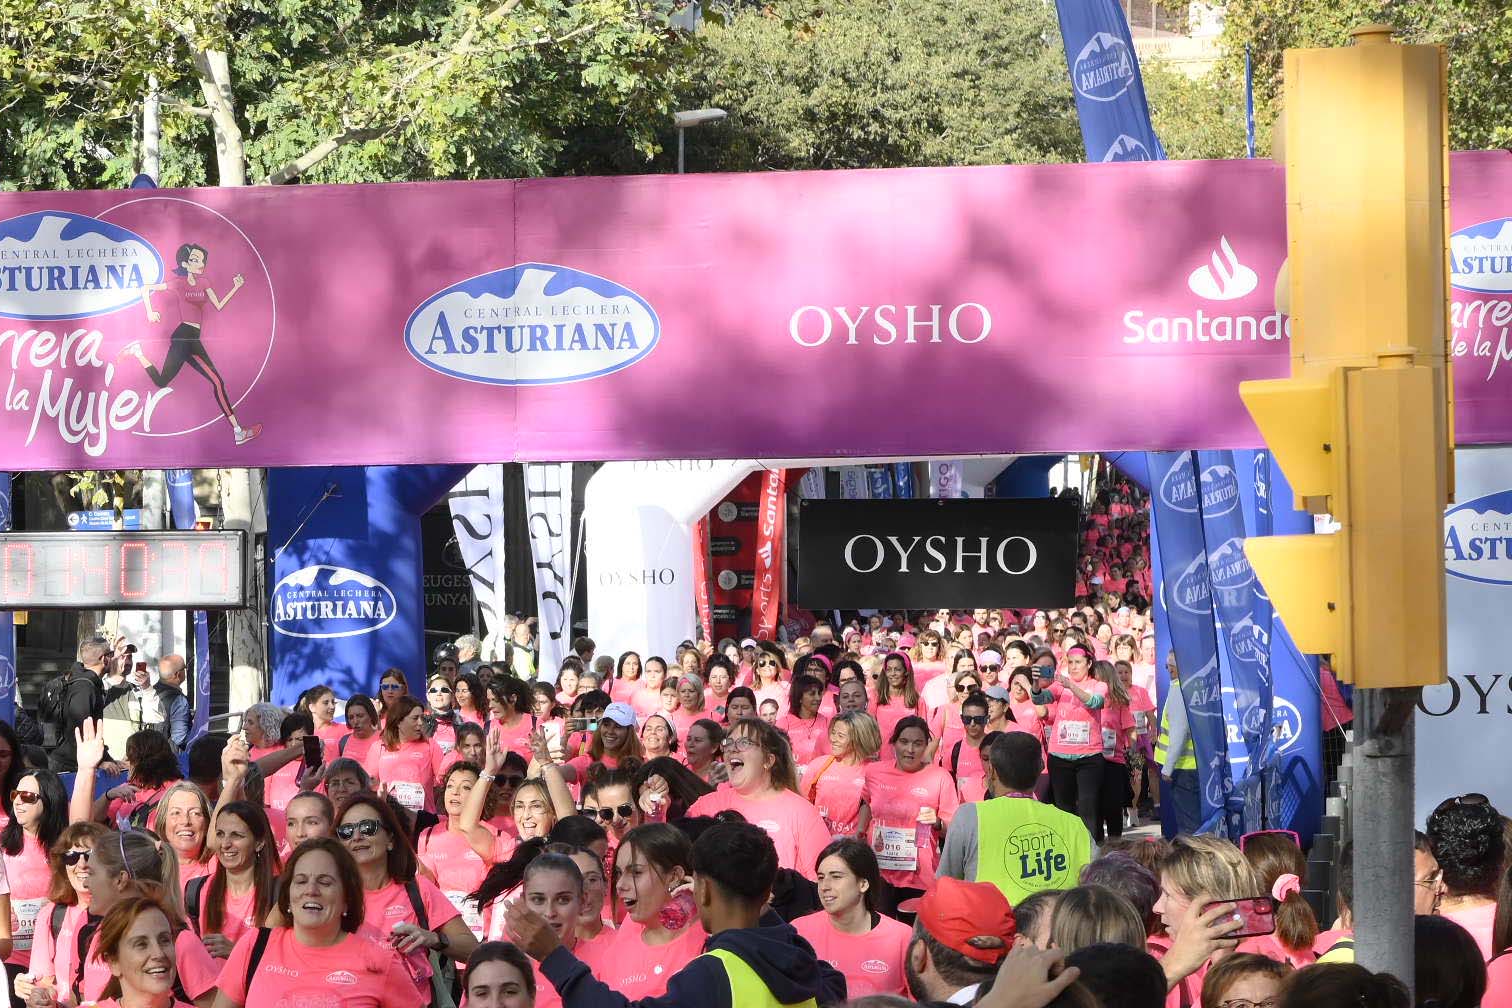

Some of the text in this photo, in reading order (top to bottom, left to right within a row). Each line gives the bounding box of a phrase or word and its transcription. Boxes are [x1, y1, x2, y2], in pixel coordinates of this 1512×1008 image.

[67, 246, 139, 258] LECHERA
[464, 302, 632, 320] CENTRAL LECHERA
[789, 302, 992, 346] OYSHO
[425, 309, 640, 356] ASTURIANA
[1474, 330, 1492, 357] la
[5, 370, 31, 411] la
[25, 363, 174, 457] Mujer
[844, 534, 1038, 575] OYSHO
[599, 568, 676, 586] OYSHO
[286, 588, 383, 600] CENTRAL LECHERA
[274, 599, 387, 622] ASTURIANA
[1009, 830, 1056, 856] Sport
[1019, 848, 1067, 882] Life
[265, 965, 299, 978] OYSHO
